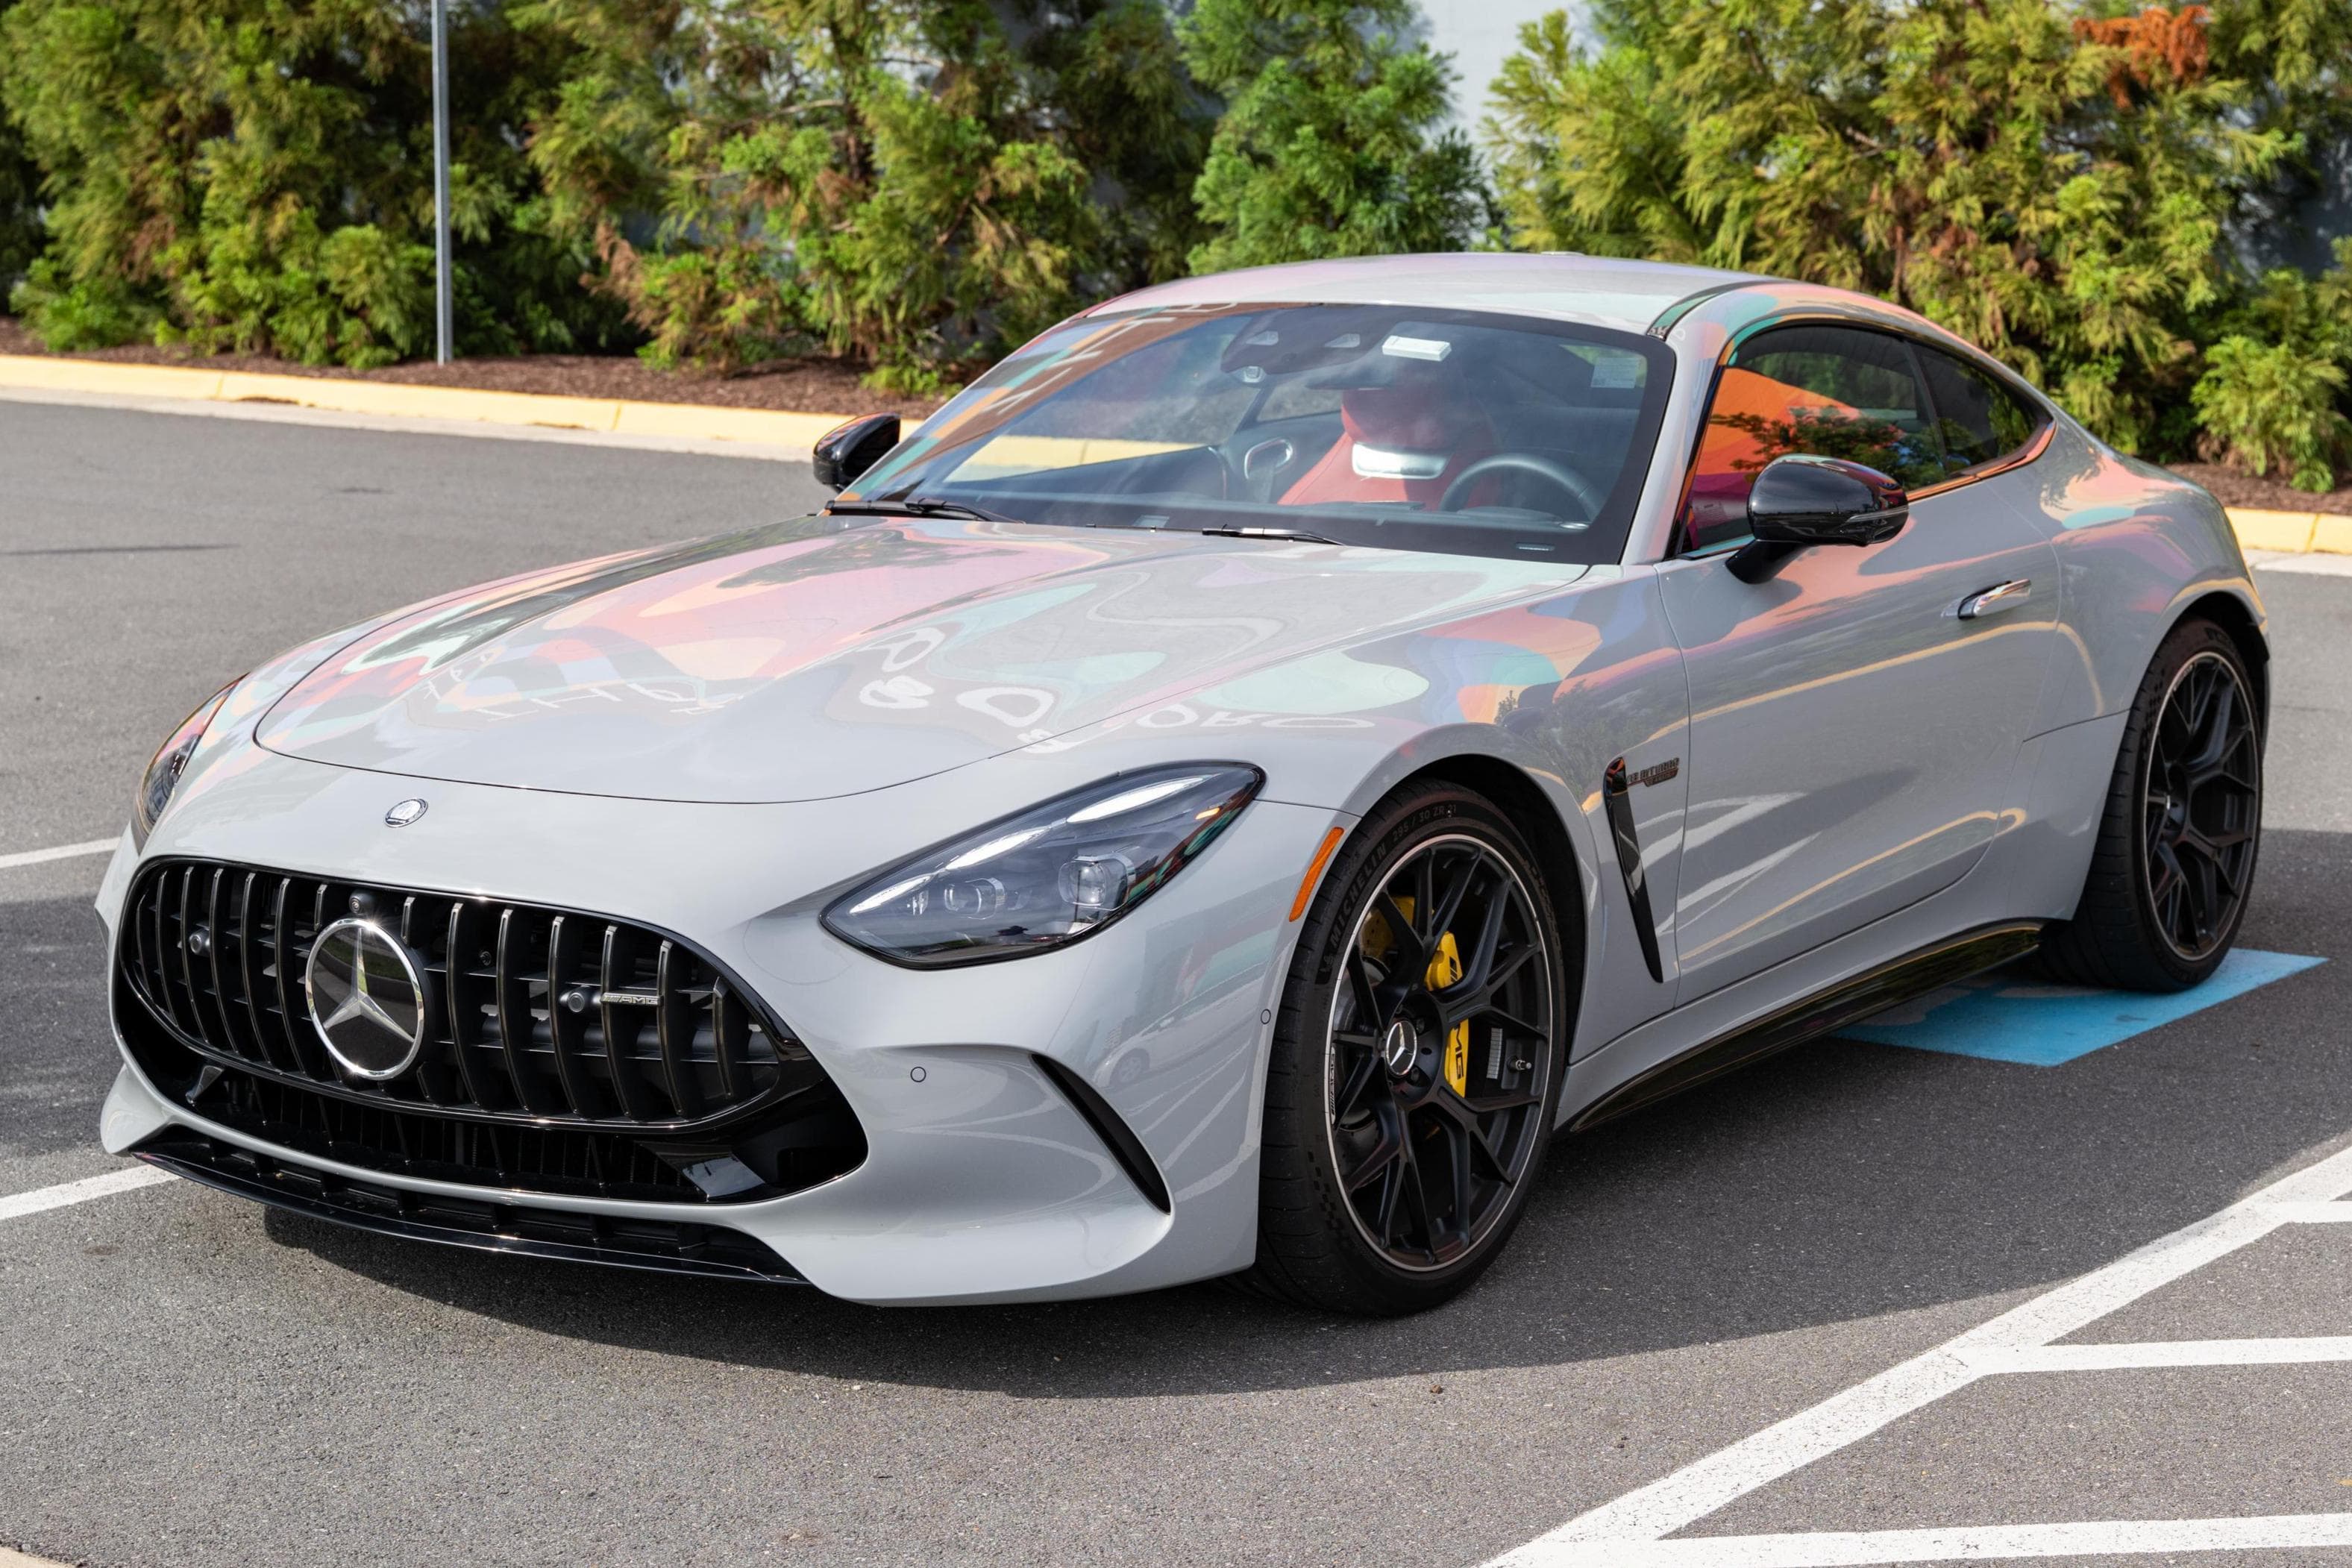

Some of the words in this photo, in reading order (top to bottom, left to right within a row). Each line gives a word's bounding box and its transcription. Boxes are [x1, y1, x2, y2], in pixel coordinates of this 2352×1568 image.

[1432, 806, 1445, 817] ZR
[1330, 845, 1387, 948] MICHELIN
[618, 997, 658, 1005] AMG
[1452, 1023, 1464, 1079] MG
